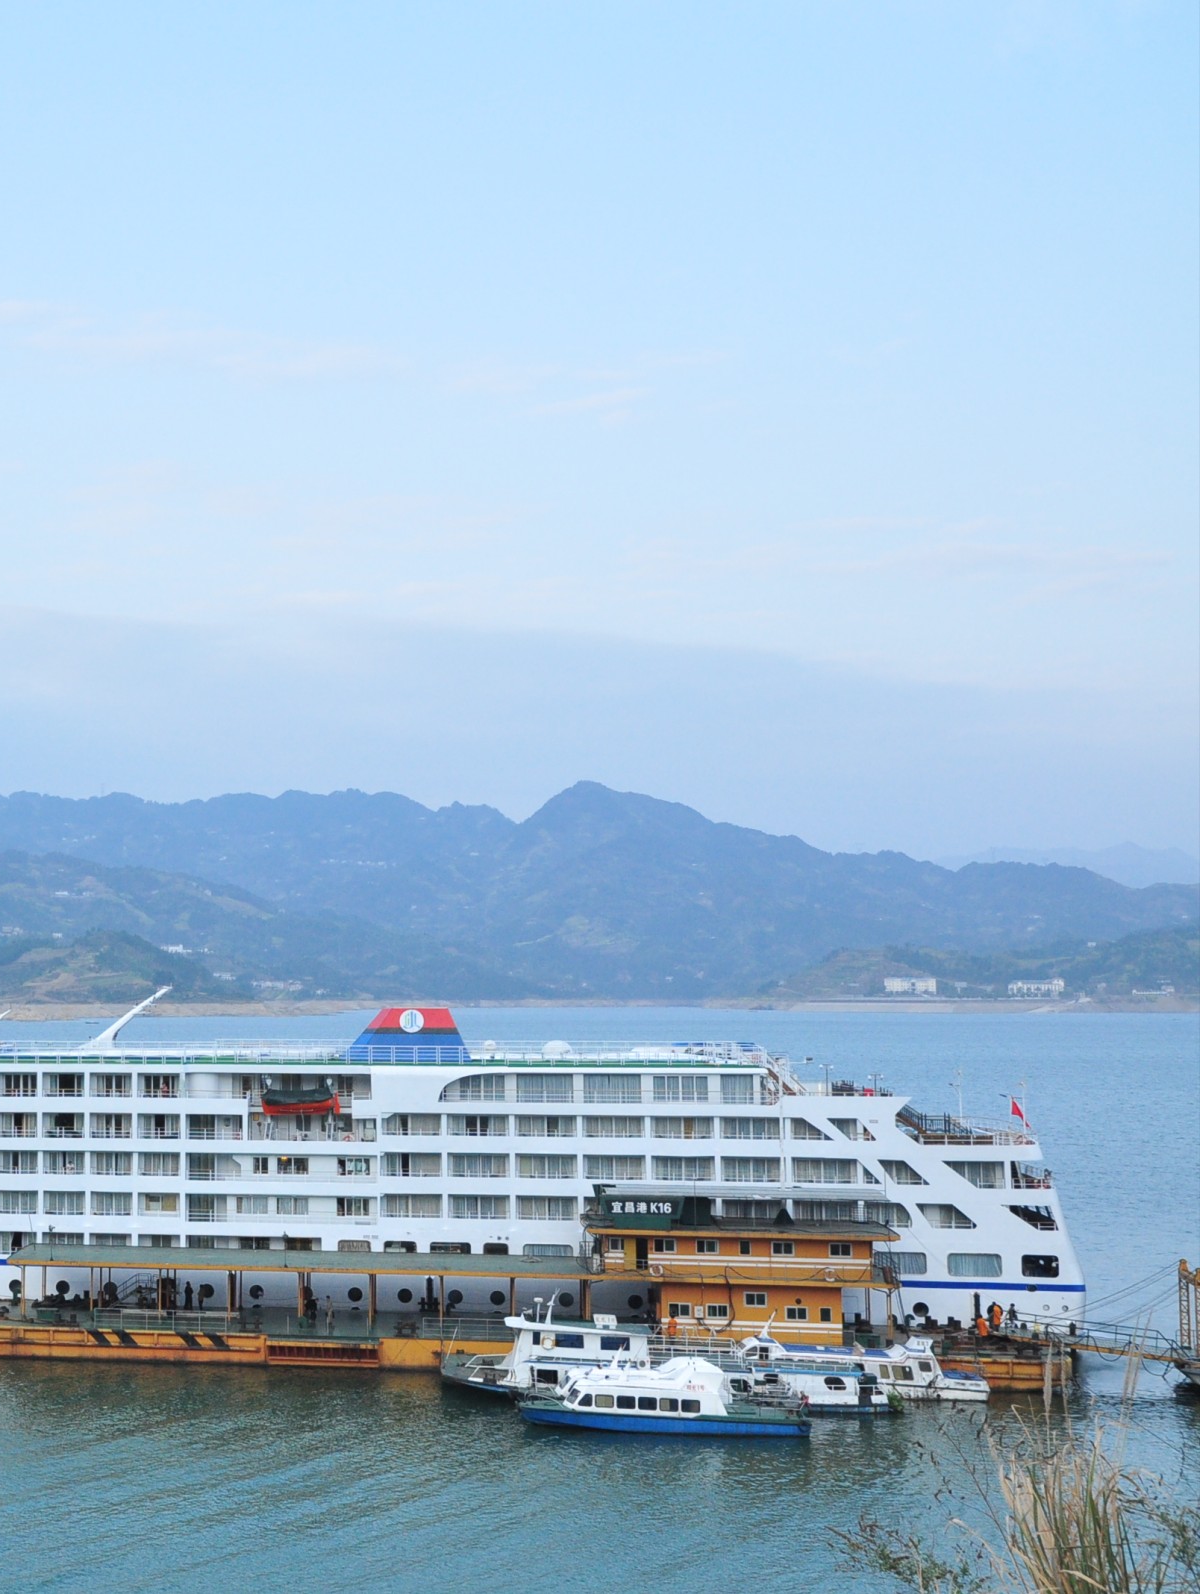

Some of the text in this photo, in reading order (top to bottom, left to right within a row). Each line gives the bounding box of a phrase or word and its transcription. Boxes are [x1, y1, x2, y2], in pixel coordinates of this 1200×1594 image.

[611, 1201, 672, 1214] 宜昌港 K16
